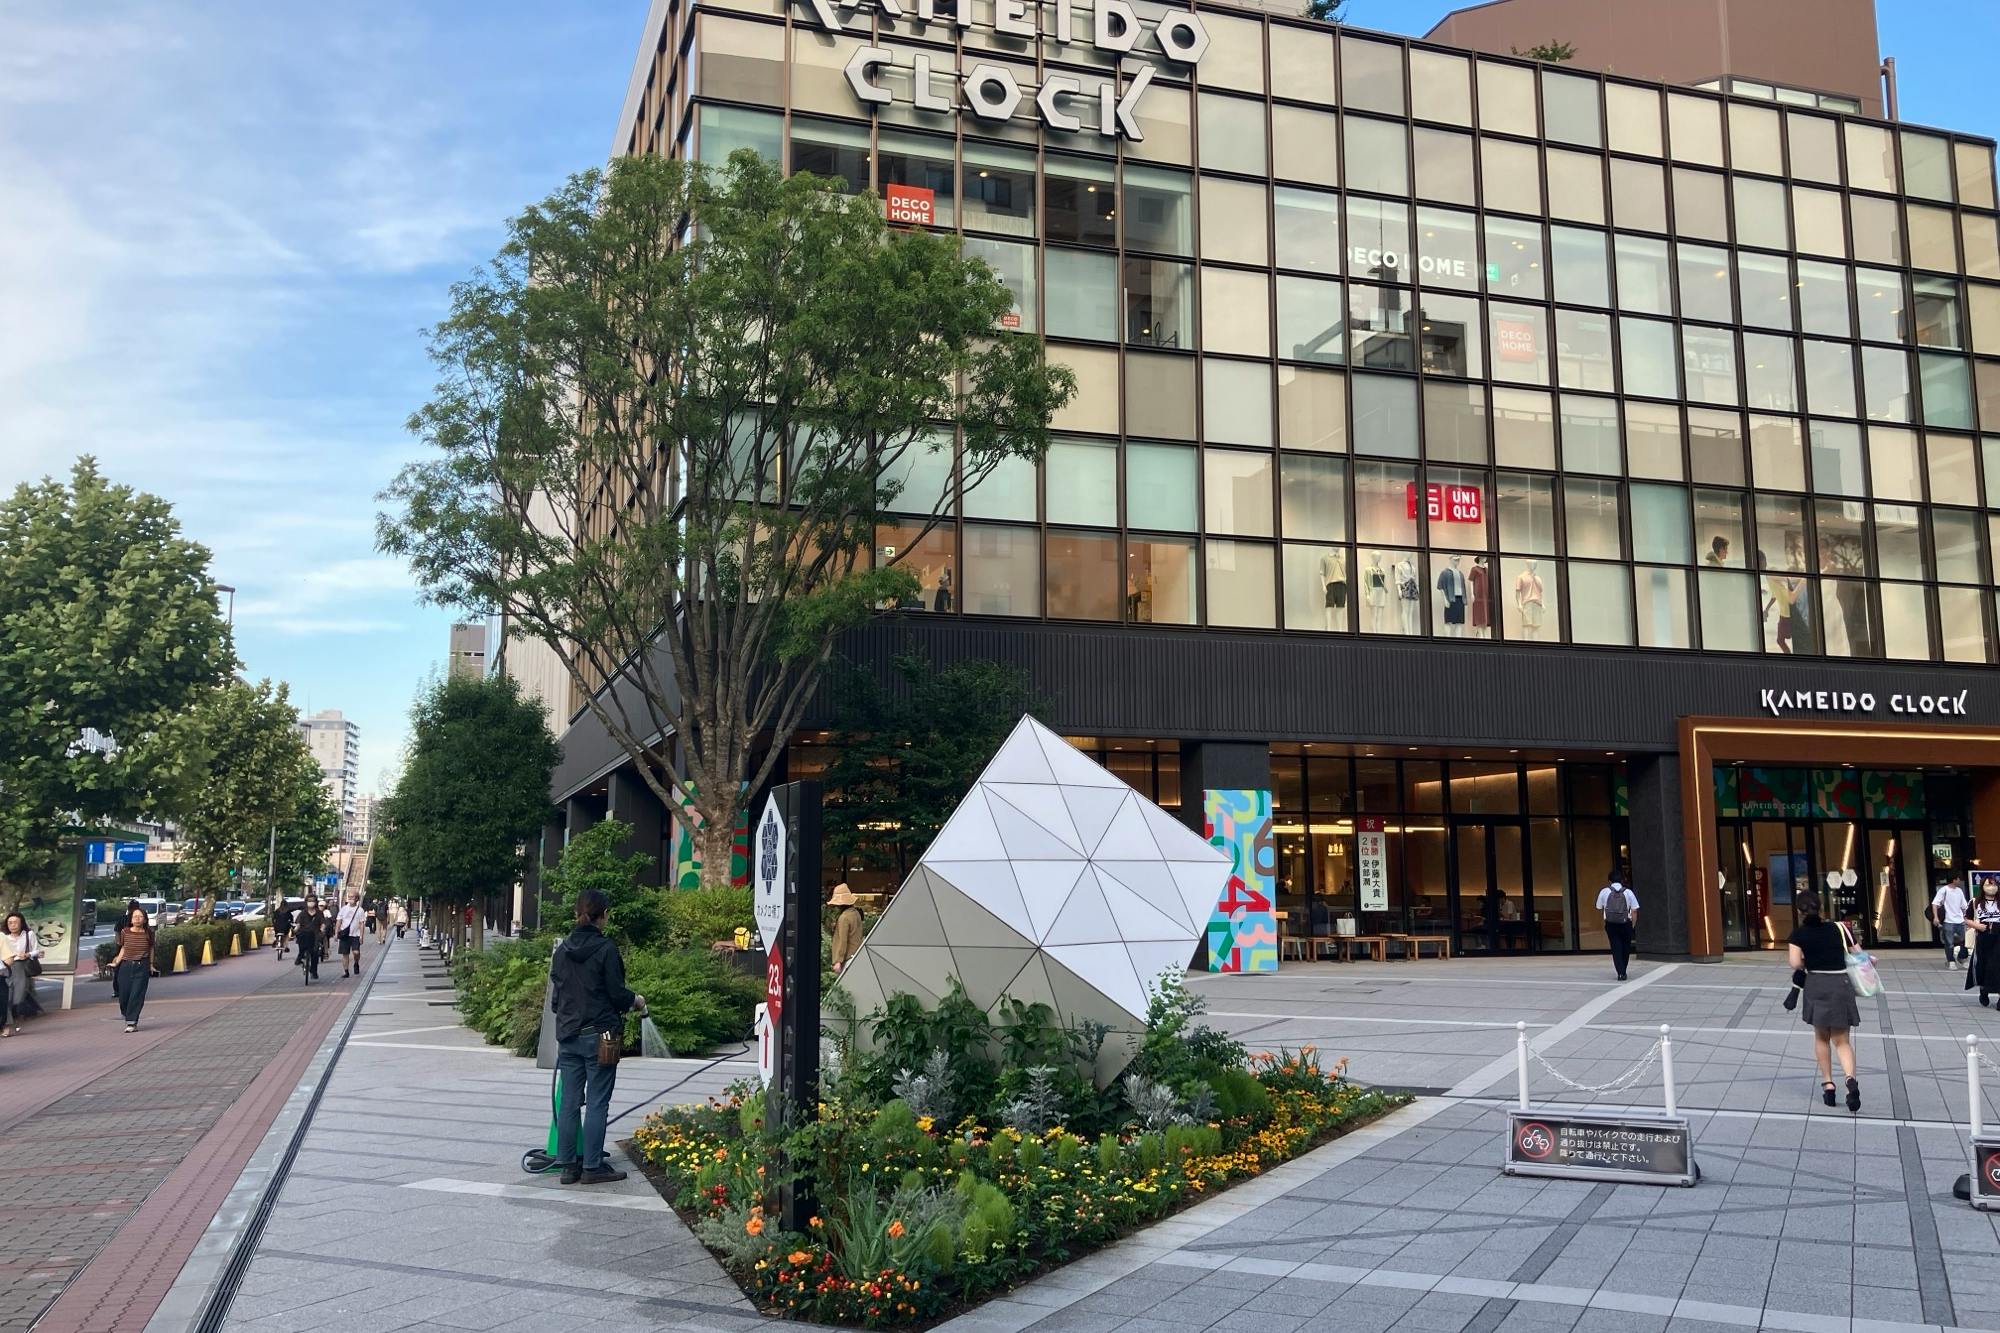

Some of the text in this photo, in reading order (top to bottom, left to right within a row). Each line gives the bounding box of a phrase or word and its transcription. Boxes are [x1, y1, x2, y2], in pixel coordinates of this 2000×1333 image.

[843, 45, 1157, 142] CLOCK
[891, 196, 930, 210] DECO
[891, 209, 930, 224] HOME
[1348, 247, 1398, 268] ECO
[1500, 329, 1532, 342] DECO
[1501, 340, 1533, 352] HOME
[1452, 490, 1475, 505] UNI
[1453, 504, 1478, 520] QLO
[1761, 689, 1968, 716] KAMEIDO CLOCK
[1366, 818, 1375, 829] 祝
[1361, 837, 1370, 856] 2位
[1370, 836, 1379, 856] 優勝
[1371, 859, 1381, 898] 伊藤大貴
[768, 963, 779, 996] 23
[1560, 1127, 1681, 1144] 自転車やバイクでの走行および
[1559, 1138, 1641, 1153] 通り抜けは禁止です。
[1559, 1149, 1651, 1164] 降りて通行して下さい。
